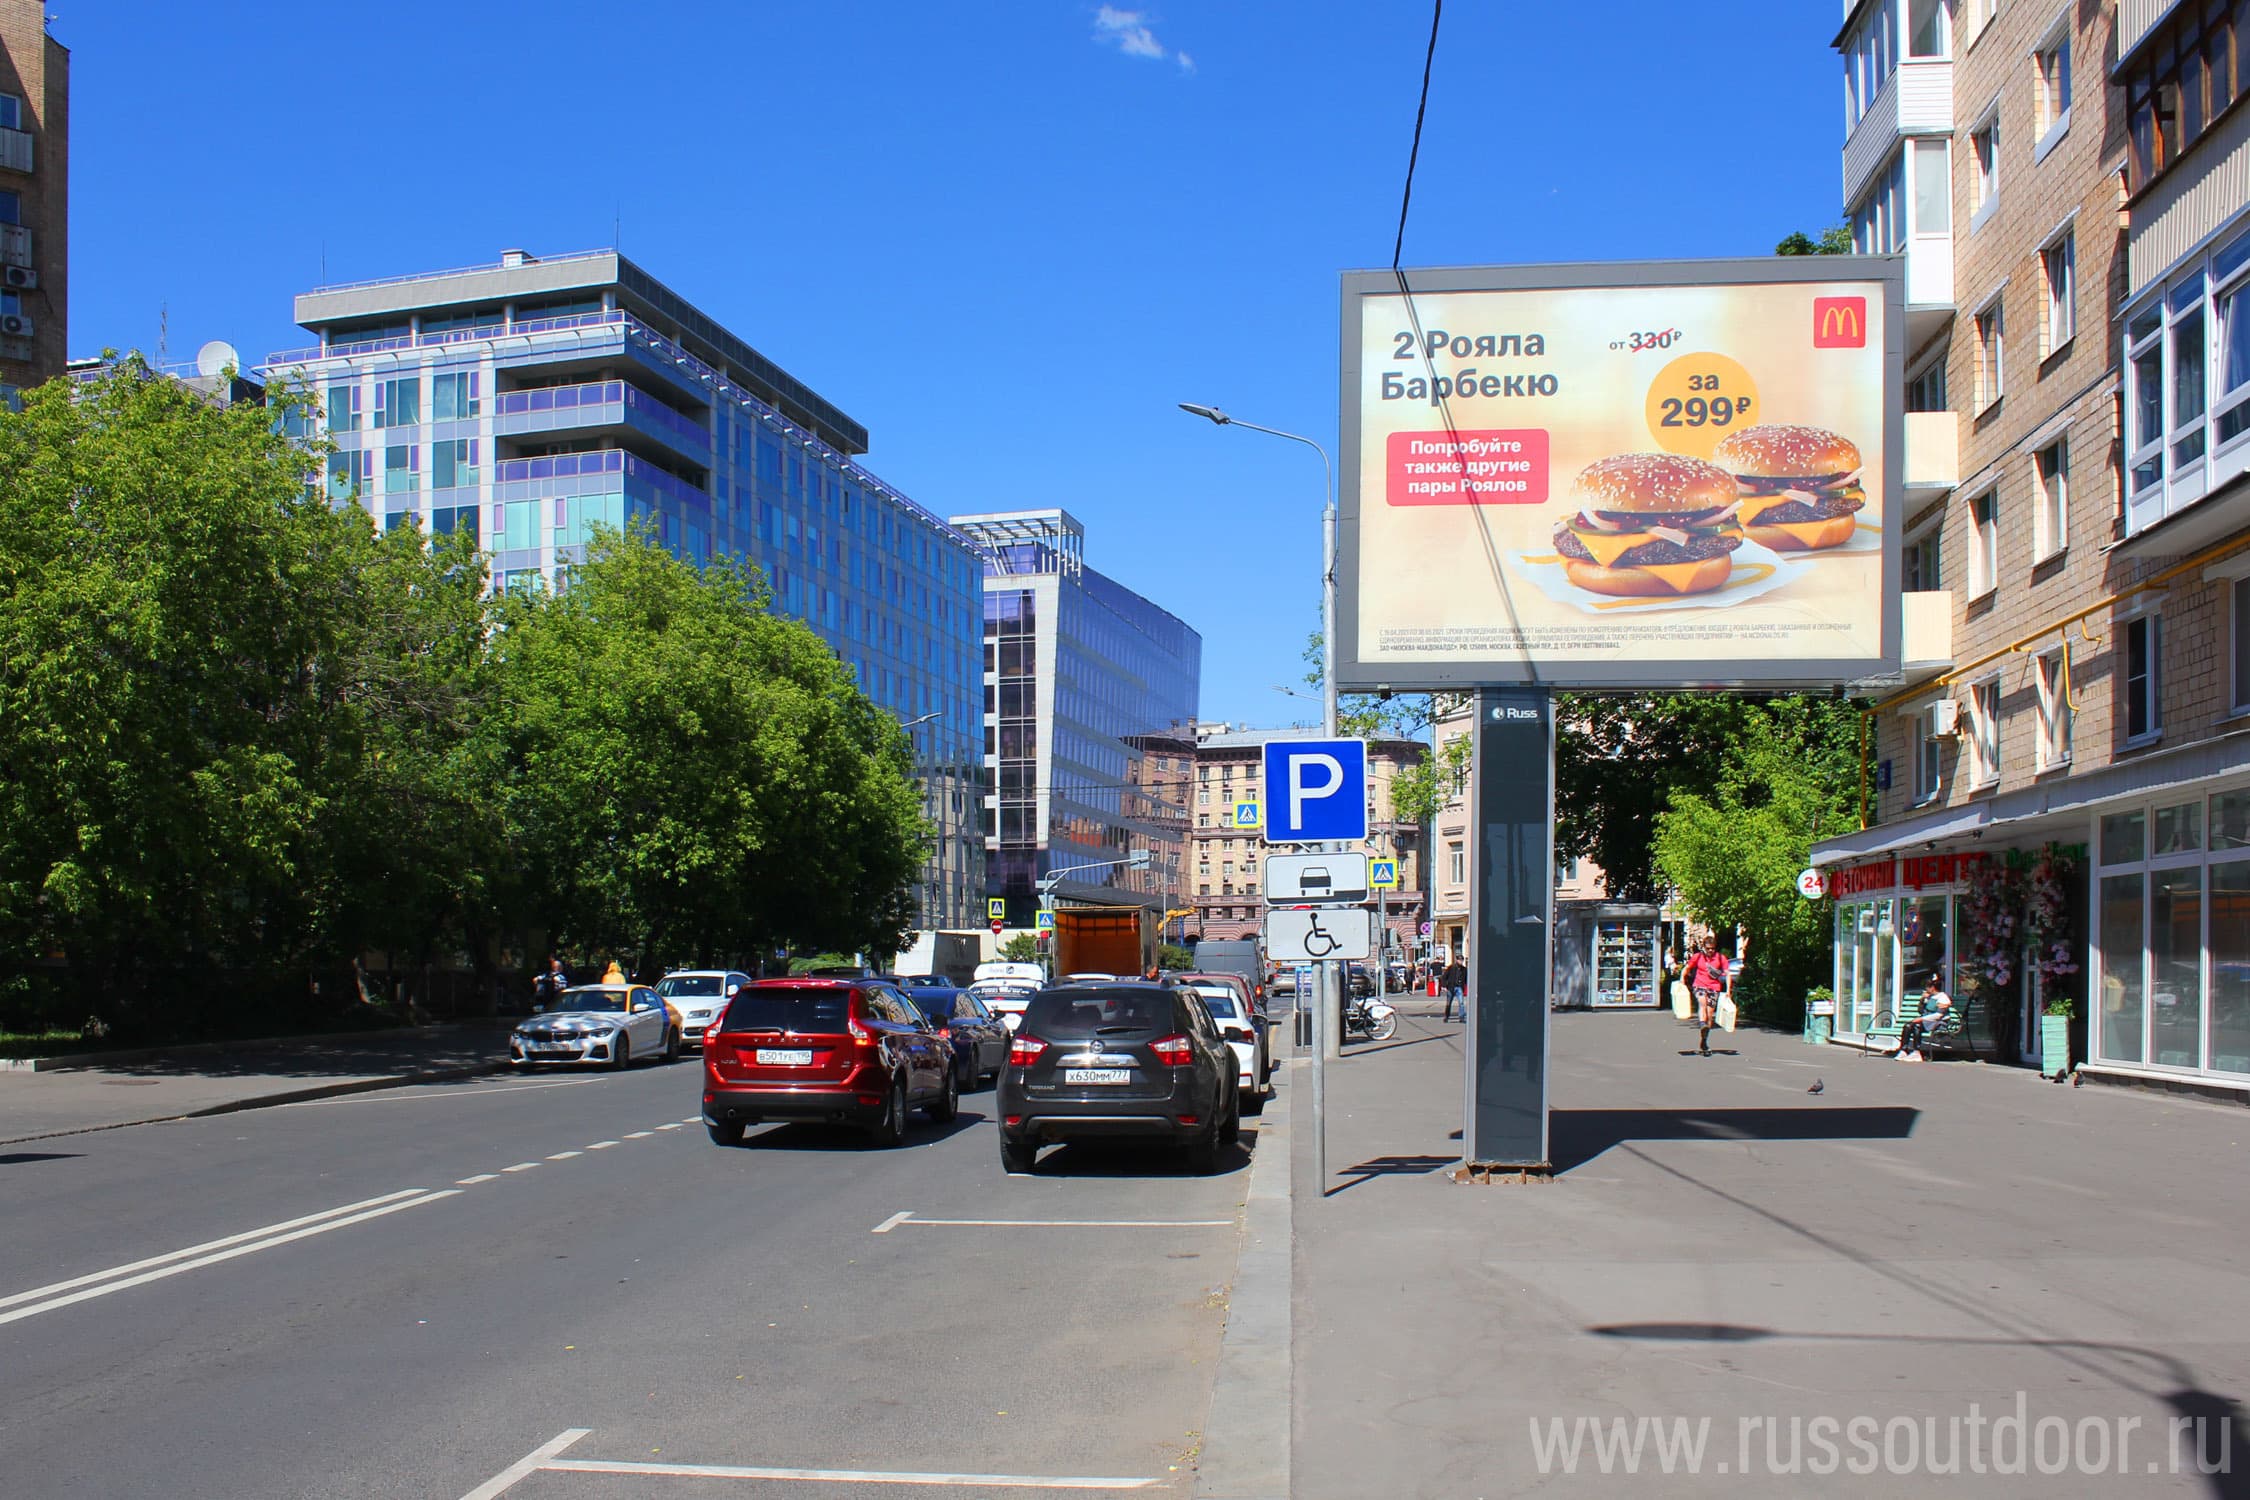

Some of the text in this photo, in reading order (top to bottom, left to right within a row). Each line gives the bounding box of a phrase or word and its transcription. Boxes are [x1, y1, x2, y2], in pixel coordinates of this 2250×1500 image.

[1393, 330, 1545, 360] 2 Рояла
[1609, 341, 1626, 350] от
[1382, 368, 1559, 407] Барбекю
[1688, 374, 1719, 391] за
[1410, 438, 1522, 457] Попробуйте
[1405, 460, 1531, 476] также другие
[1408, 478, 1528, 496] пары Роялов
[1507, 708, 1538, 718] Russ
[1289, 754, 1344, 830] P
[1803, 876, 1825, 889] 24
